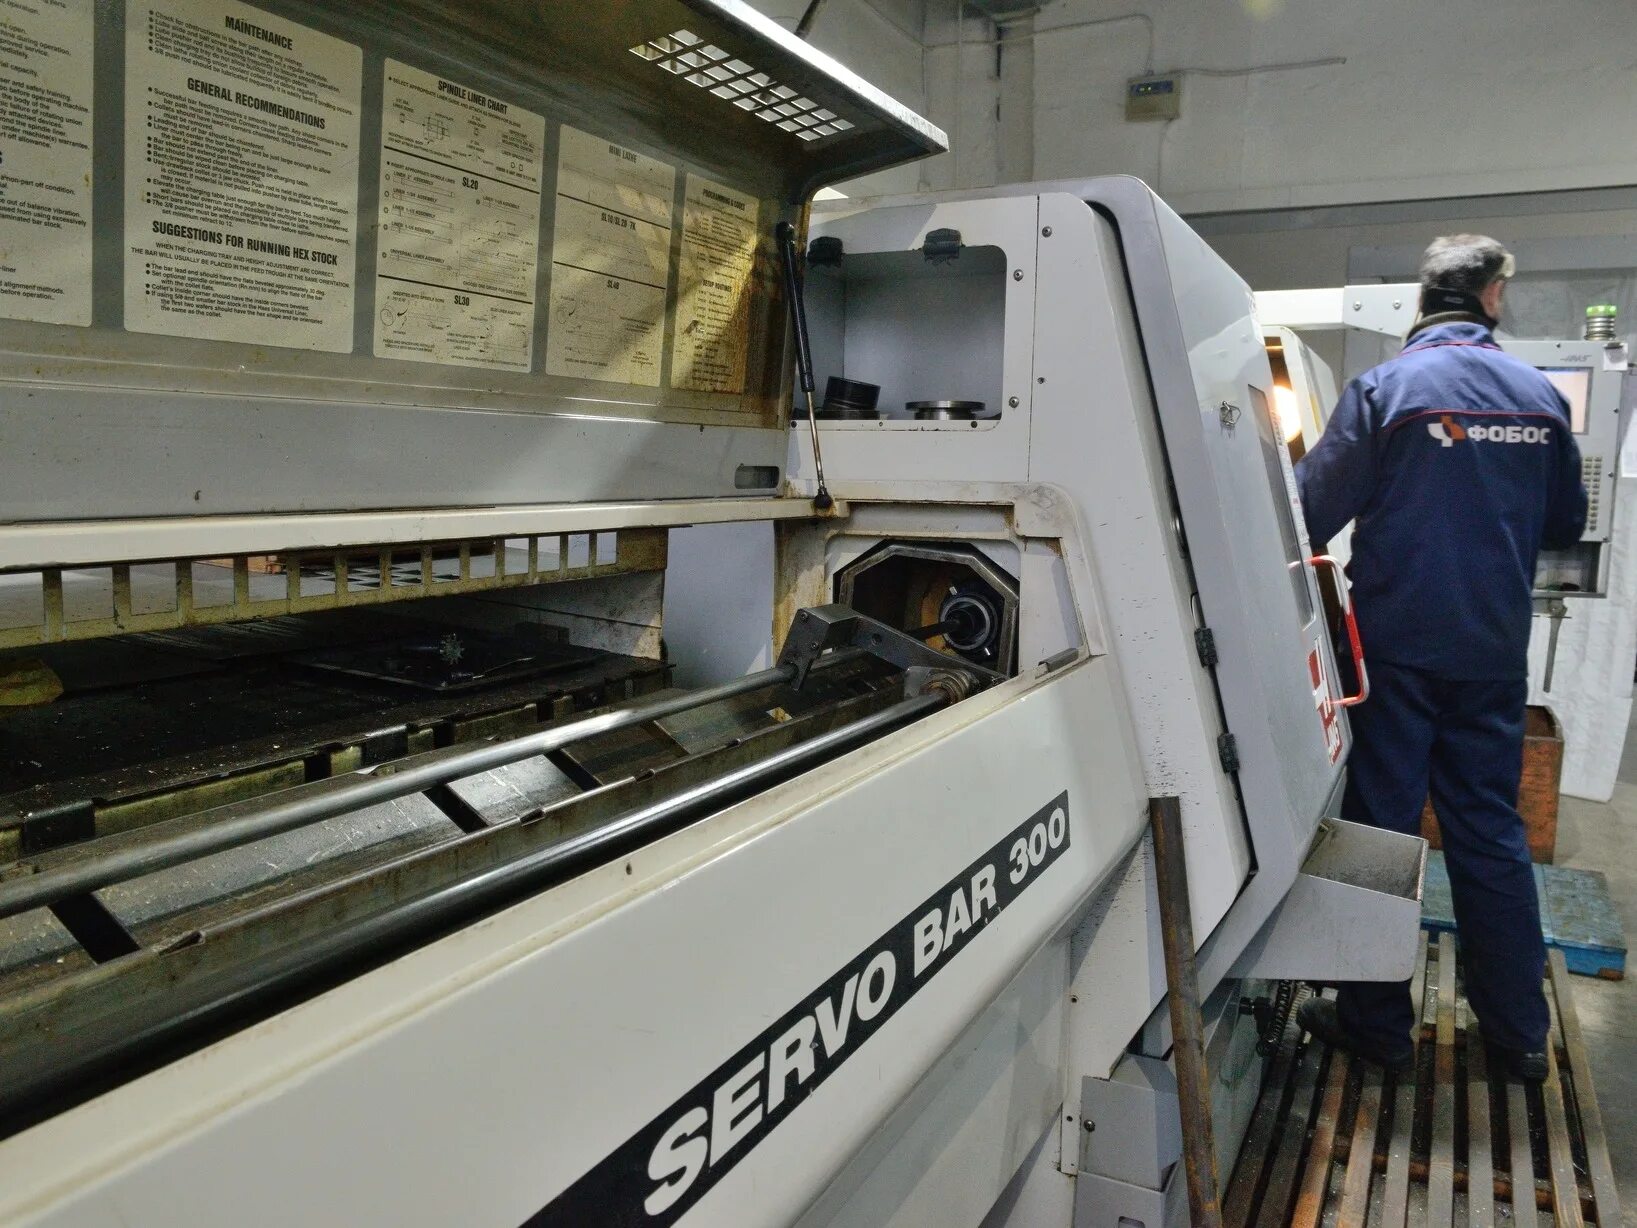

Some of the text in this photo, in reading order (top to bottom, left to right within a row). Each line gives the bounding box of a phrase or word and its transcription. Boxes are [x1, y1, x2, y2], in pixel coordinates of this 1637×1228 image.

[225, 14, 292, 51] MAINTENANCE
[1, 92, 12, 100] the
[13, 95, 30, 106] body
[39, 102, 49, 110] the
[187, 76, 325, 129] GENERAL RECOMMENDATIONS
[438, 80, 508, 115] SPINDLE LINER CHART
[15, 119, 65, 136] the spindle liner.
[462, 177, 478, 190] SL20
[17, 207, 86, 226] from using excessively
[26, 202, 51, 211] balance
[52, 206, 79, 216] vibration.
[152, 219, 337, 265] SUGGESTIONS FOR RUNNING HEX STOCK
[155, 242, 173, 250] WHEN
[187, 248, 217, 257] CHARGING
[266, 261, 298, 271] ADJUSTMENT
[174, 255, 199, 264] USUALLY
[210, 261, 232, 269] PLACED
[454, 295, 469, 306] SL30
[1467, 424, 1551, 445] ФОБОС
[644, 806, 1066, 1216] SERVO BAR 300
